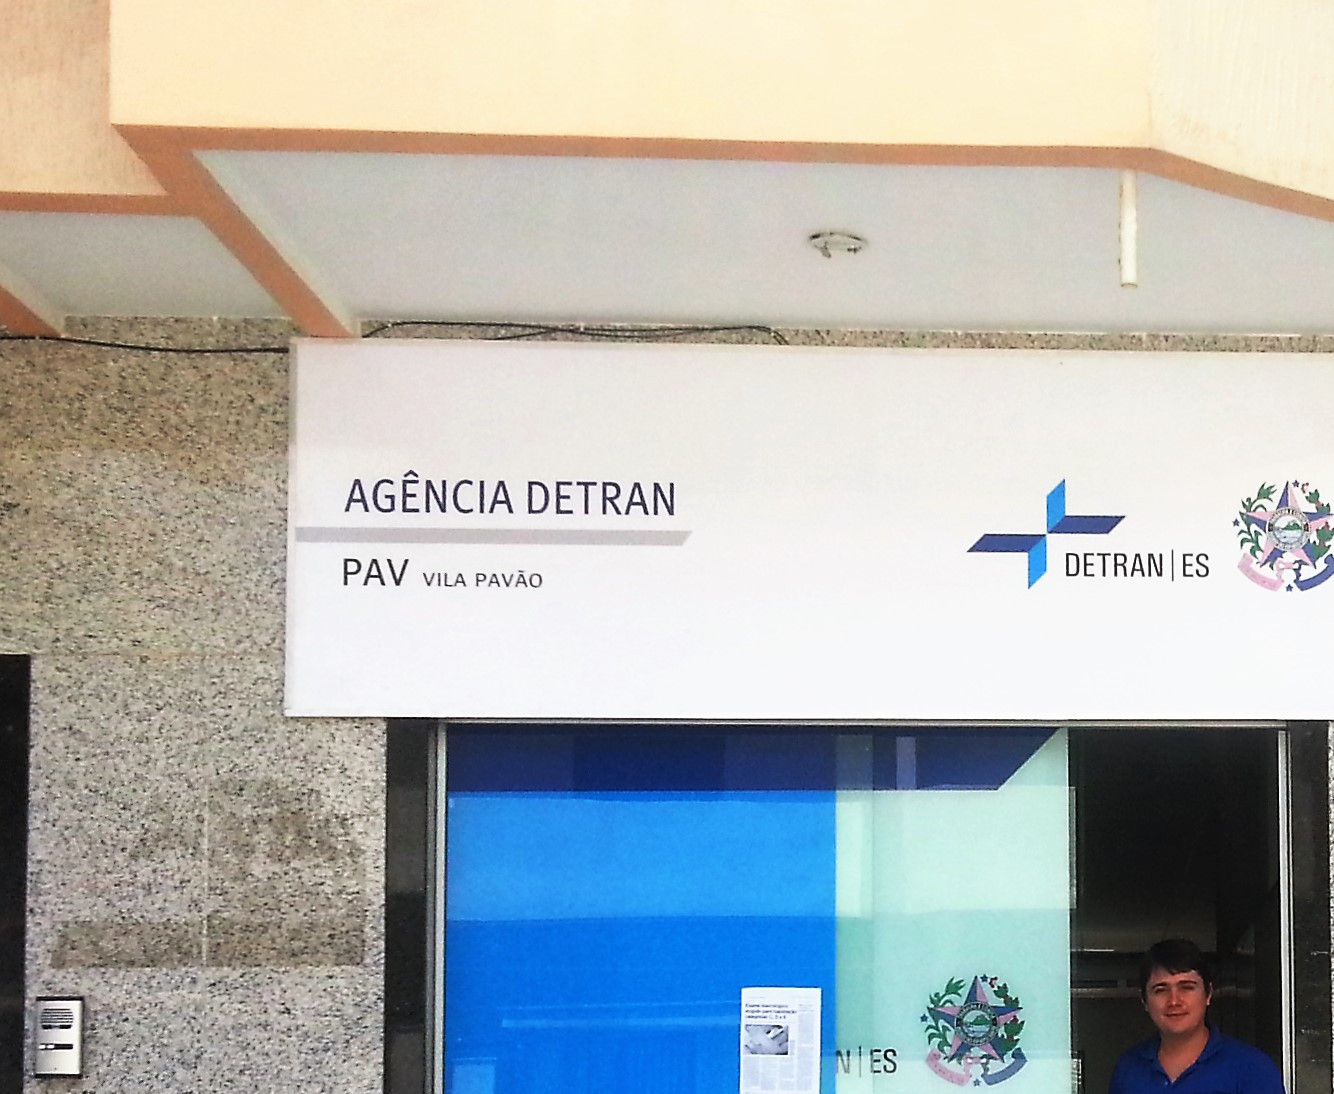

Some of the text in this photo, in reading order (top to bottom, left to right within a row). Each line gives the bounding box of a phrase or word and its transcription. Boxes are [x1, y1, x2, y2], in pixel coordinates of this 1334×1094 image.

[344, 469, 676, 516] AGÊNCIA DETRAN
[342, 557, 543, 589] PAV VILA PAVÃO
